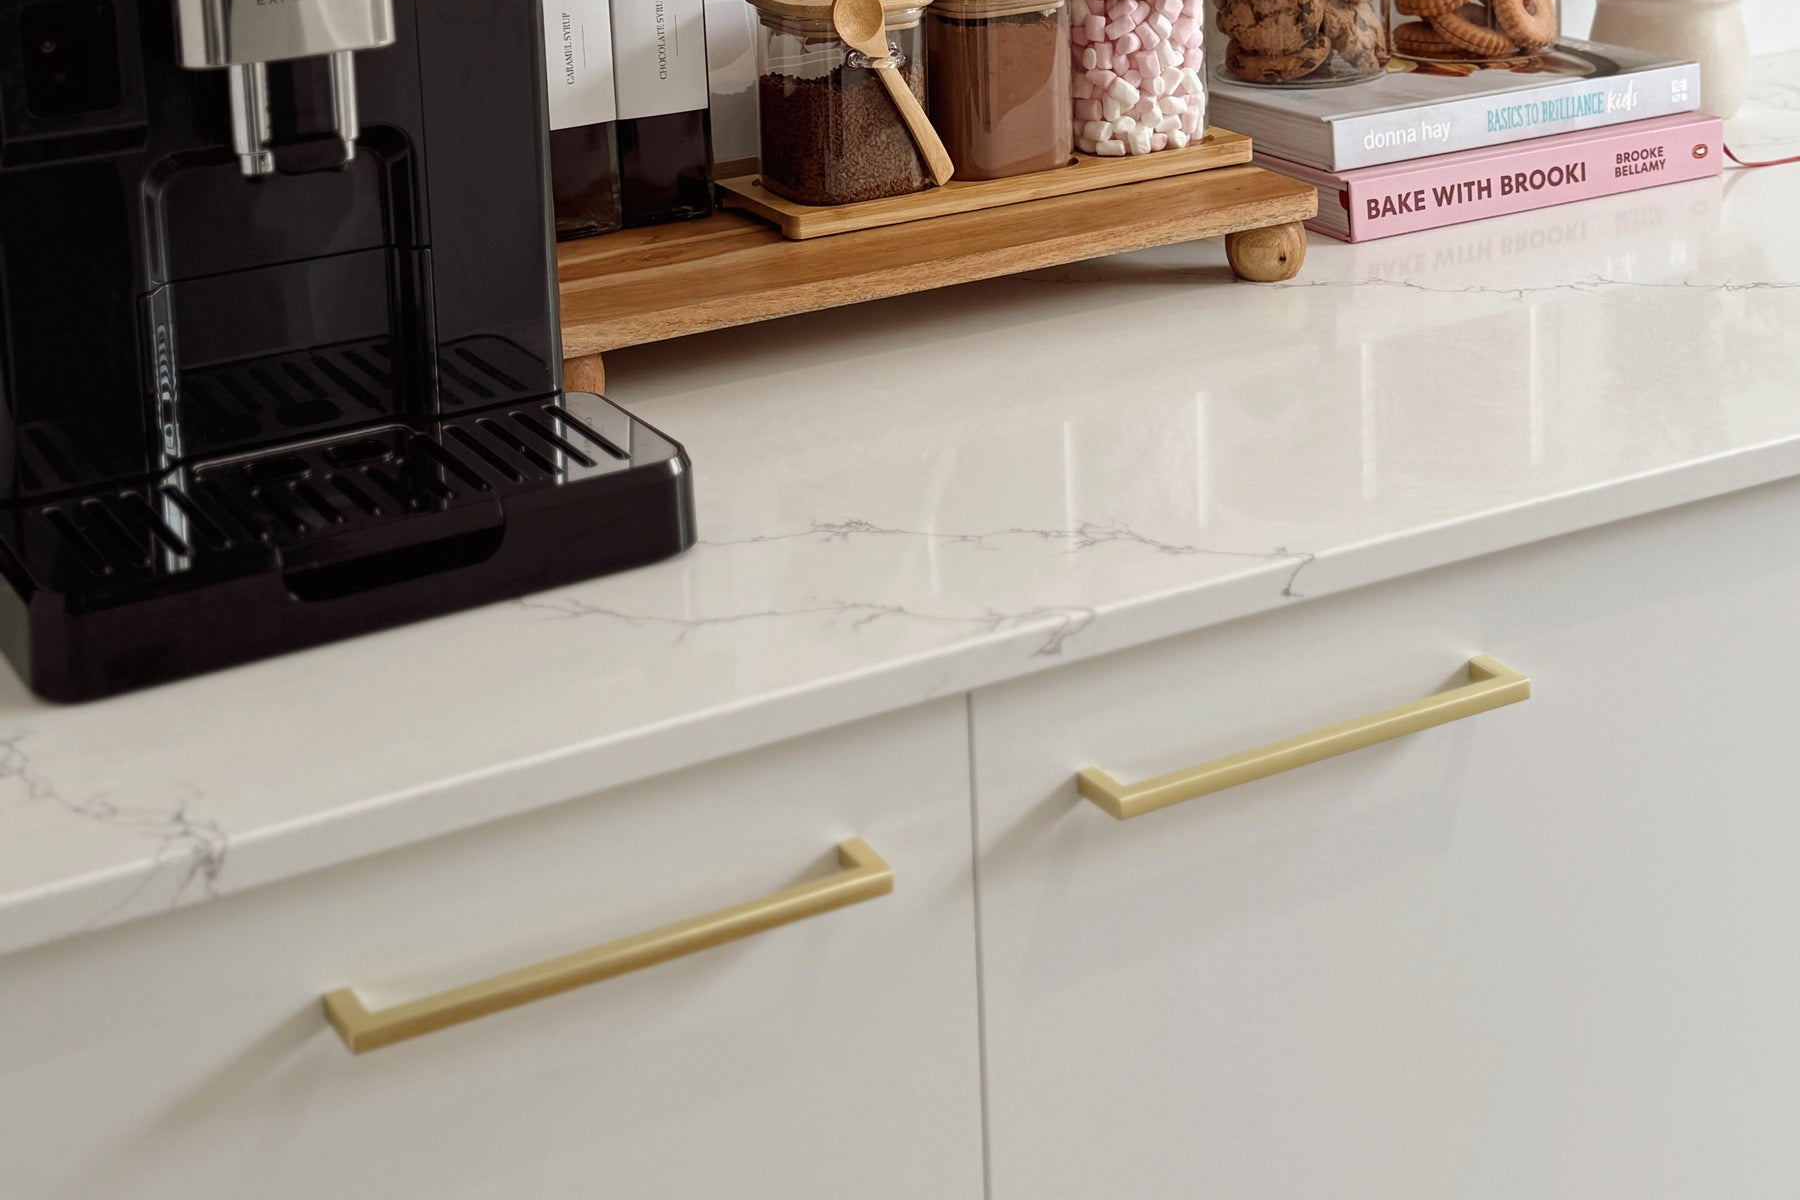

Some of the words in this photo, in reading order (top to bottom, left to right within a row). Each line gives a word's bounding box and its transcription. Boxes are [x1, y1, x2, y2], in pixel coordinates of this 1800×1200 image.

[561, 12, 572, 42] SYRUP
[563, 42, 575, 85] CARAMEL
[656, 24, 668, 80] CHOCOLATE
[1486, 104, 1524, 133] BASICS
[1523, 102, 1540, 126] TO
[1541, 92, 1604, 123] BRILLIANCE
[1363, 129, 1417, 150] donna
[1421, 120, 1451, 143] hay
[1614, 158, 1667, 178] BELLAMY
[1615, 146, 1664, 164] BROOKE
[1366, 189, 1427, 220] BAKE
[1431, 178, 1493, 208] WITH
[1499, 161, 1587, 197] BROOKI
